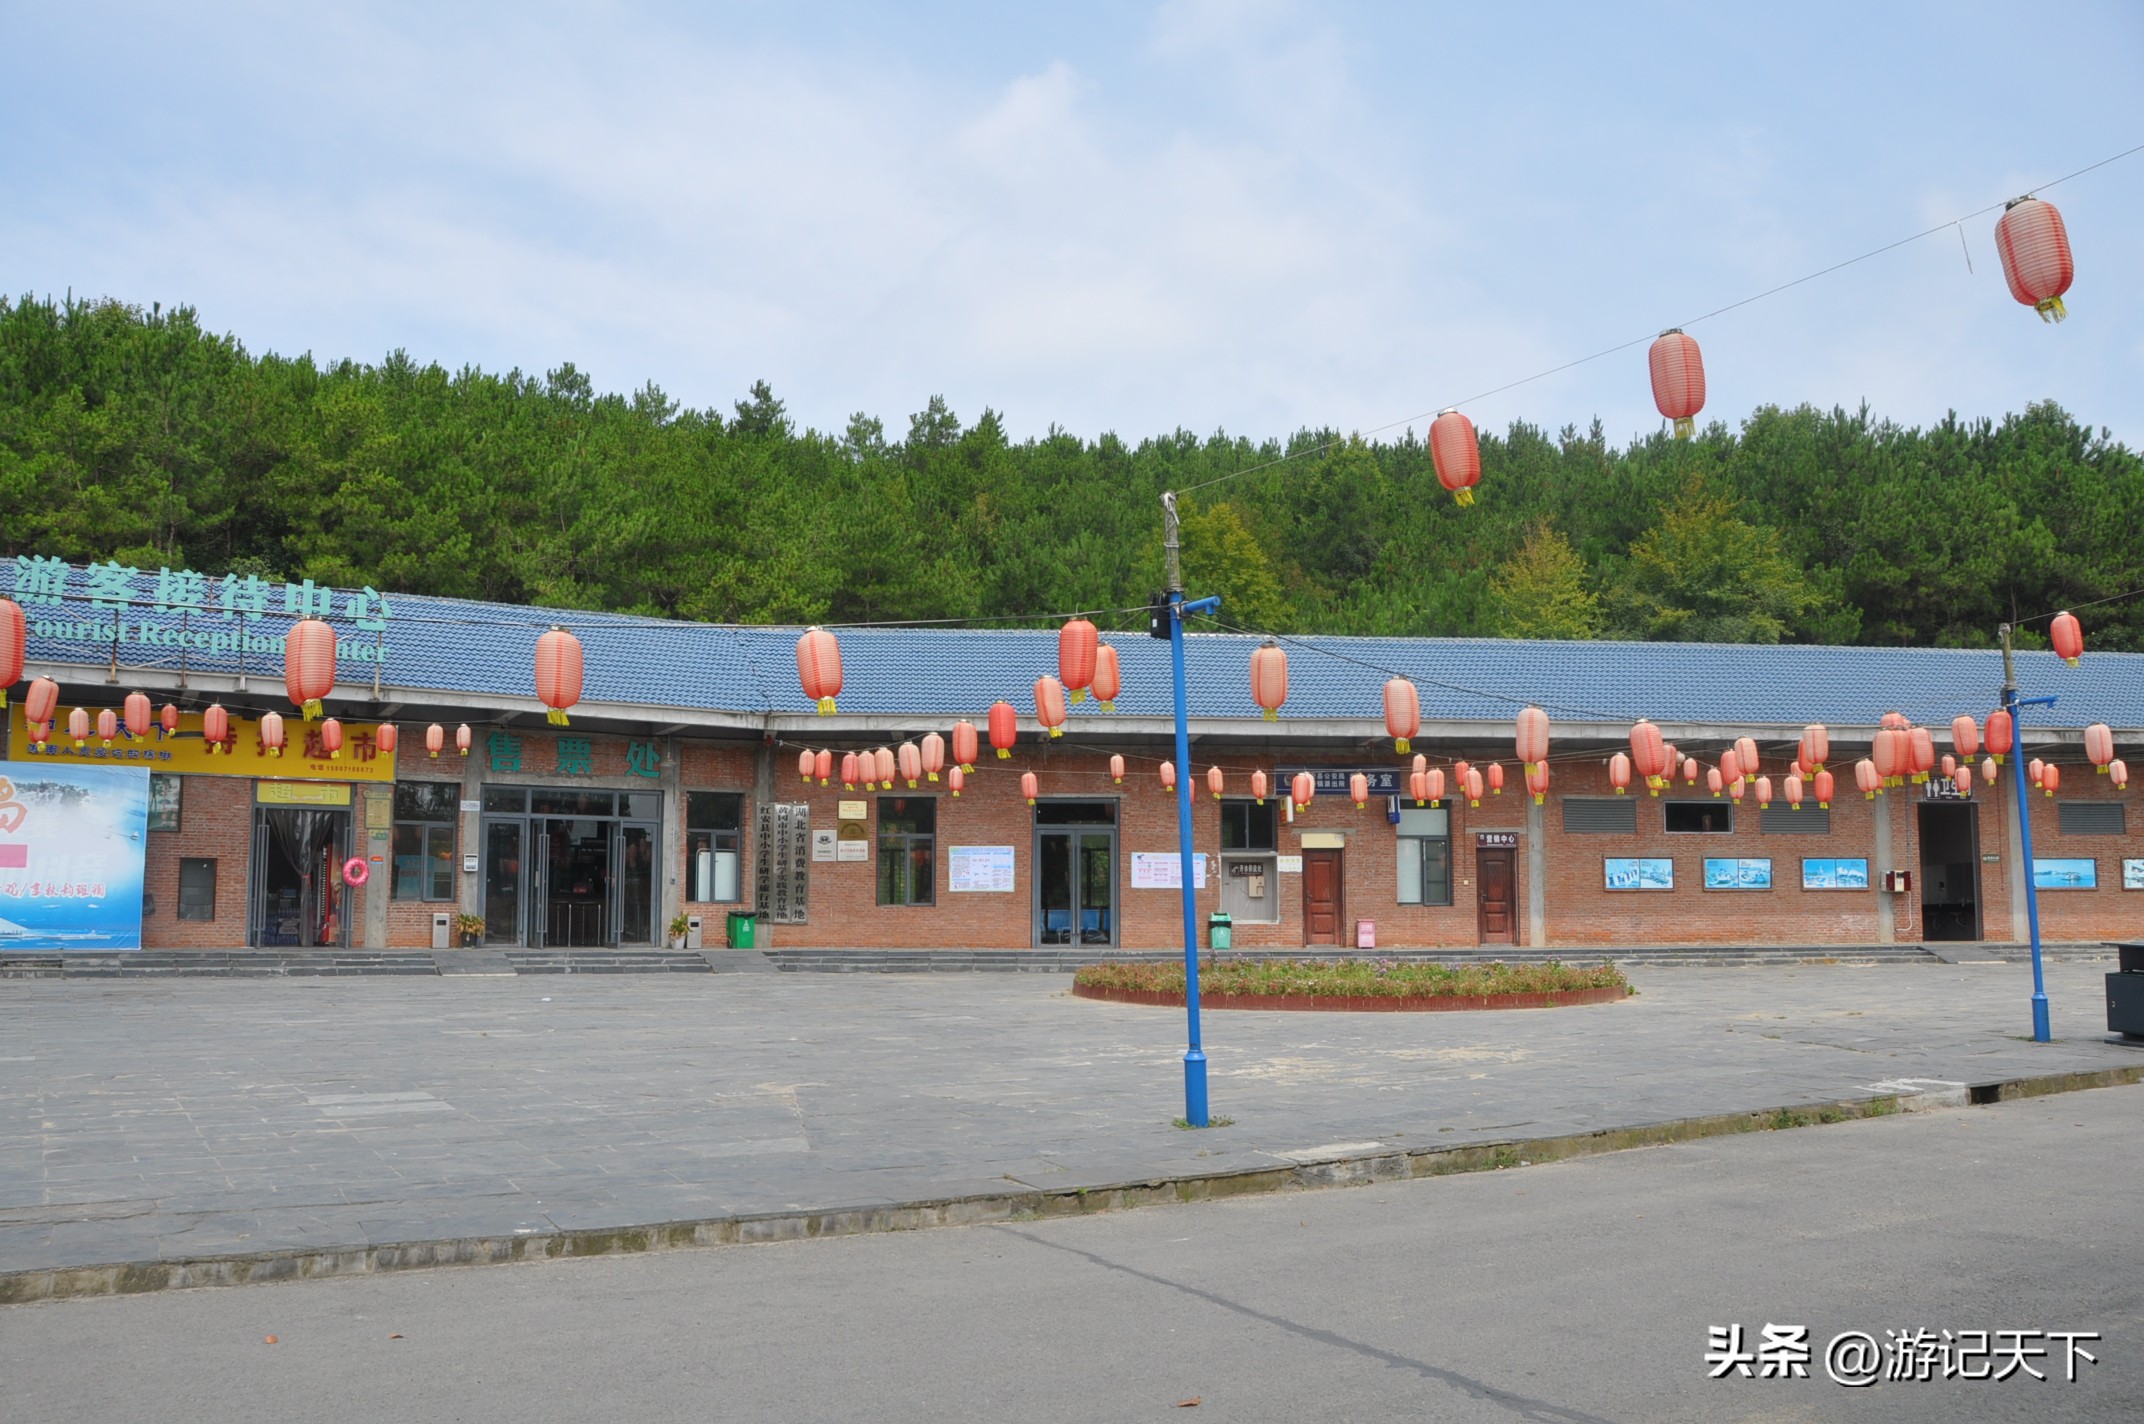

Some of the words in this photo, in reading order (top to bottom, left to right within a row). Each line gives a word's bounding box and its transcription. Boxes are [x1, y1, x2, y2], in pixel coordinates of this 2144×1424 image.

[13, 554, 393, 632] 游客接待中心
[25, 611, 128, 643] ourist
[140, 620, 286, 656] Reception
[335, 638, 390, 664] nter
[486, 730, 662, 778] 售票处
[758, 806, 771, 920] 红安县中小学生研学旅行基地
[794, 807, 807, 920] 湖北省消费教育基地
[1486, 834, 1515, 844] 营销中心
